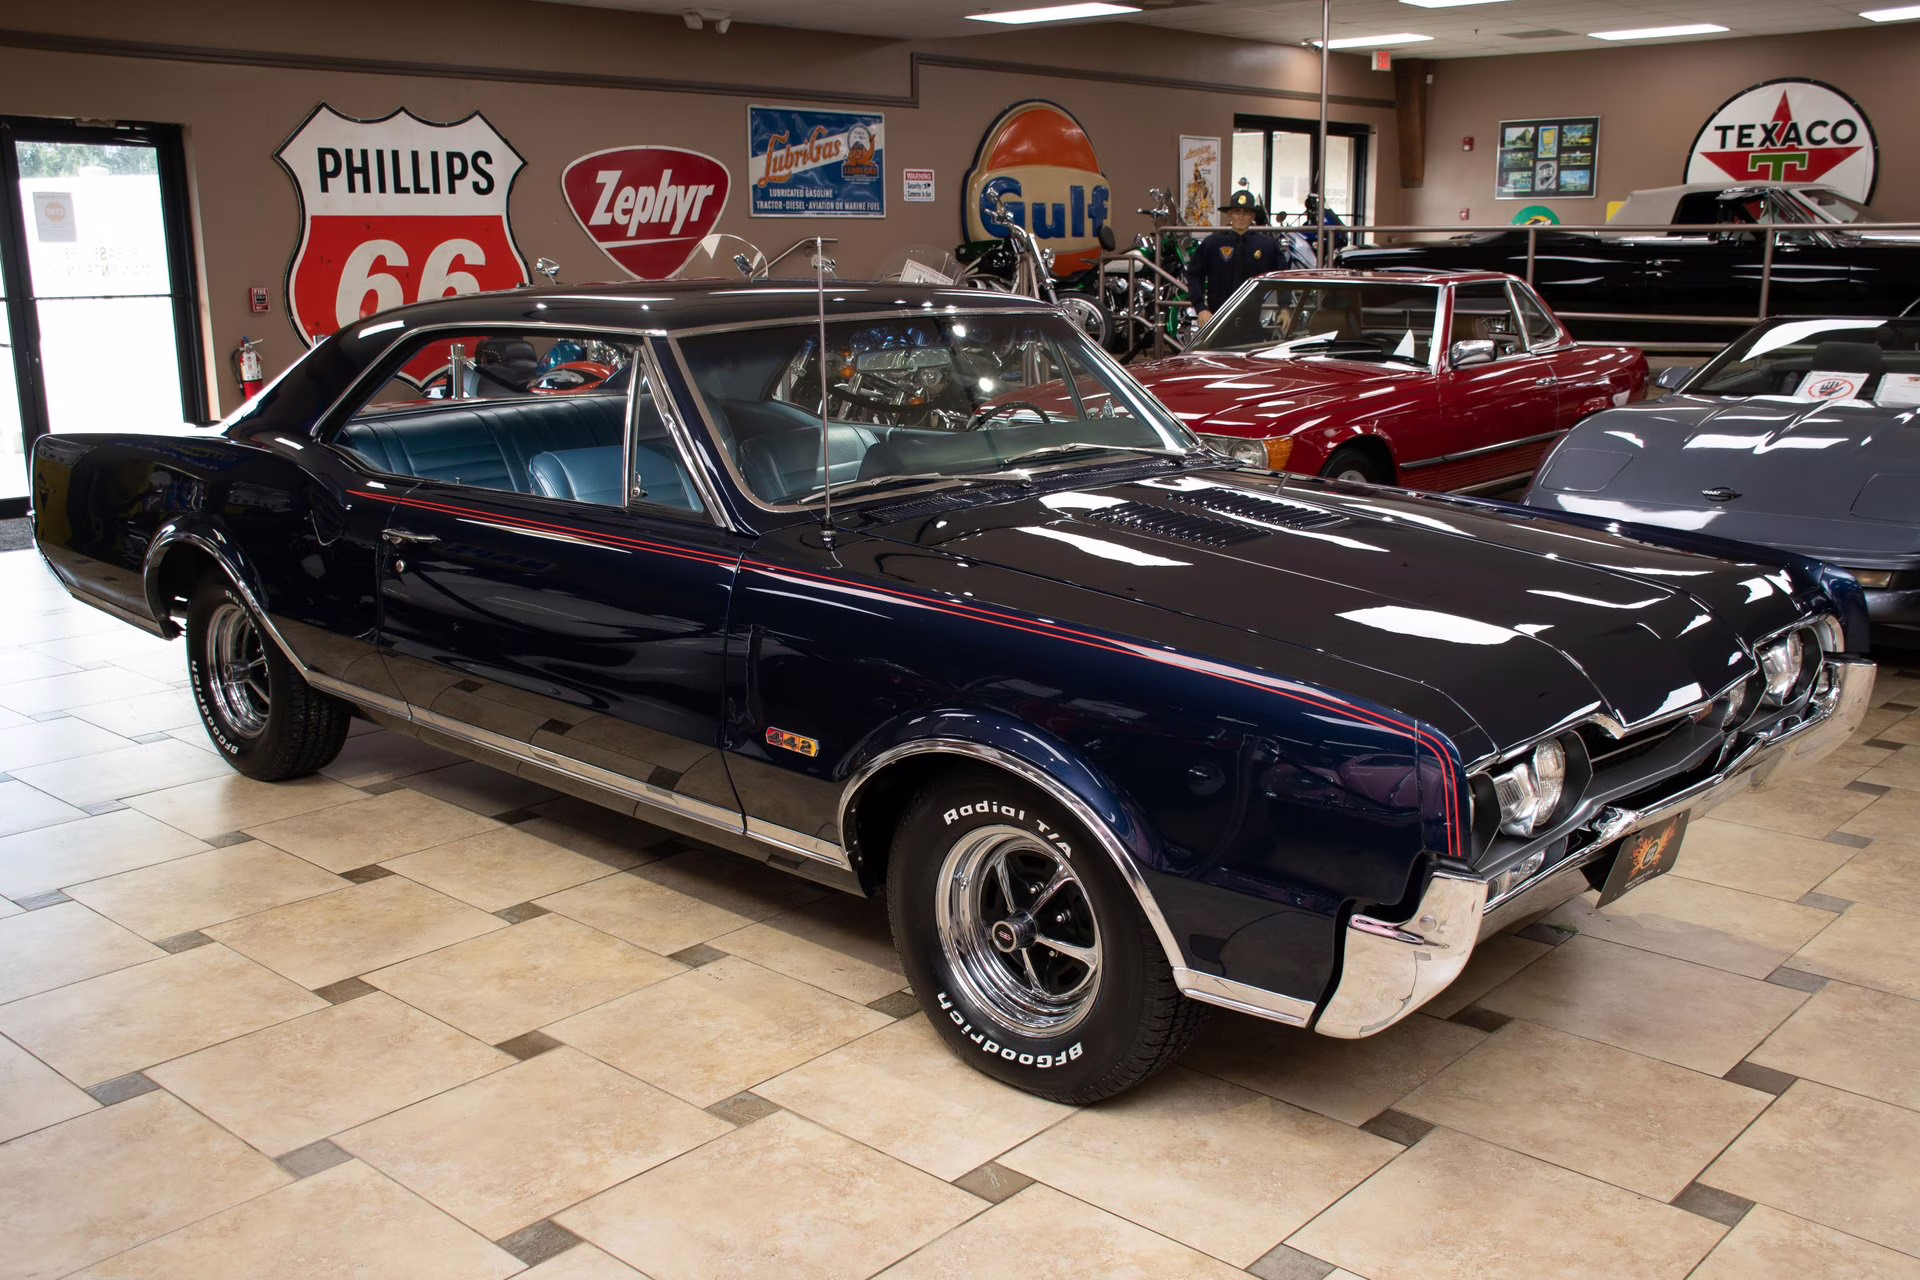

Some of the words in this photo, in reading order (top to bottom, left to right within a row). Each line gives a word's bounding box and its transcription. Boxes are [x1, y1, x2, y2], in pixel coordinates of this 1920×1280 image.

[1714, 118, 1858, 149] TEXACO
[317, 147, 495, 196] PHILLIPS
[769, 187, 804, 198] LUBRICATED
[805, 188, 833, 198] GASOLINE
[906, 172, 932, 180] WARNING
[907, 182, 922, 190] Security
[588, 169, 715, 237] Zephyr
[756, 200, 783, 210] TRACTOR
[785, 201, 805, 210] DIESEL
[808, 201, 834, 210] AVIATION
[835, 201, 843, 210] OR
[844, 202, 866, 210] MARINE
[866, 202, 880, 210] FUEL
[979, 176, 1109, 240] Gulf
[335, 238, 486, 329] 66
[191, 660, 239, 755] BFGoodrich
[943, 800, 1025, 826] Radial
[1036, 819, 1073, 860] T/A
[937, 992, 1083, 1069] BFGoodrich
